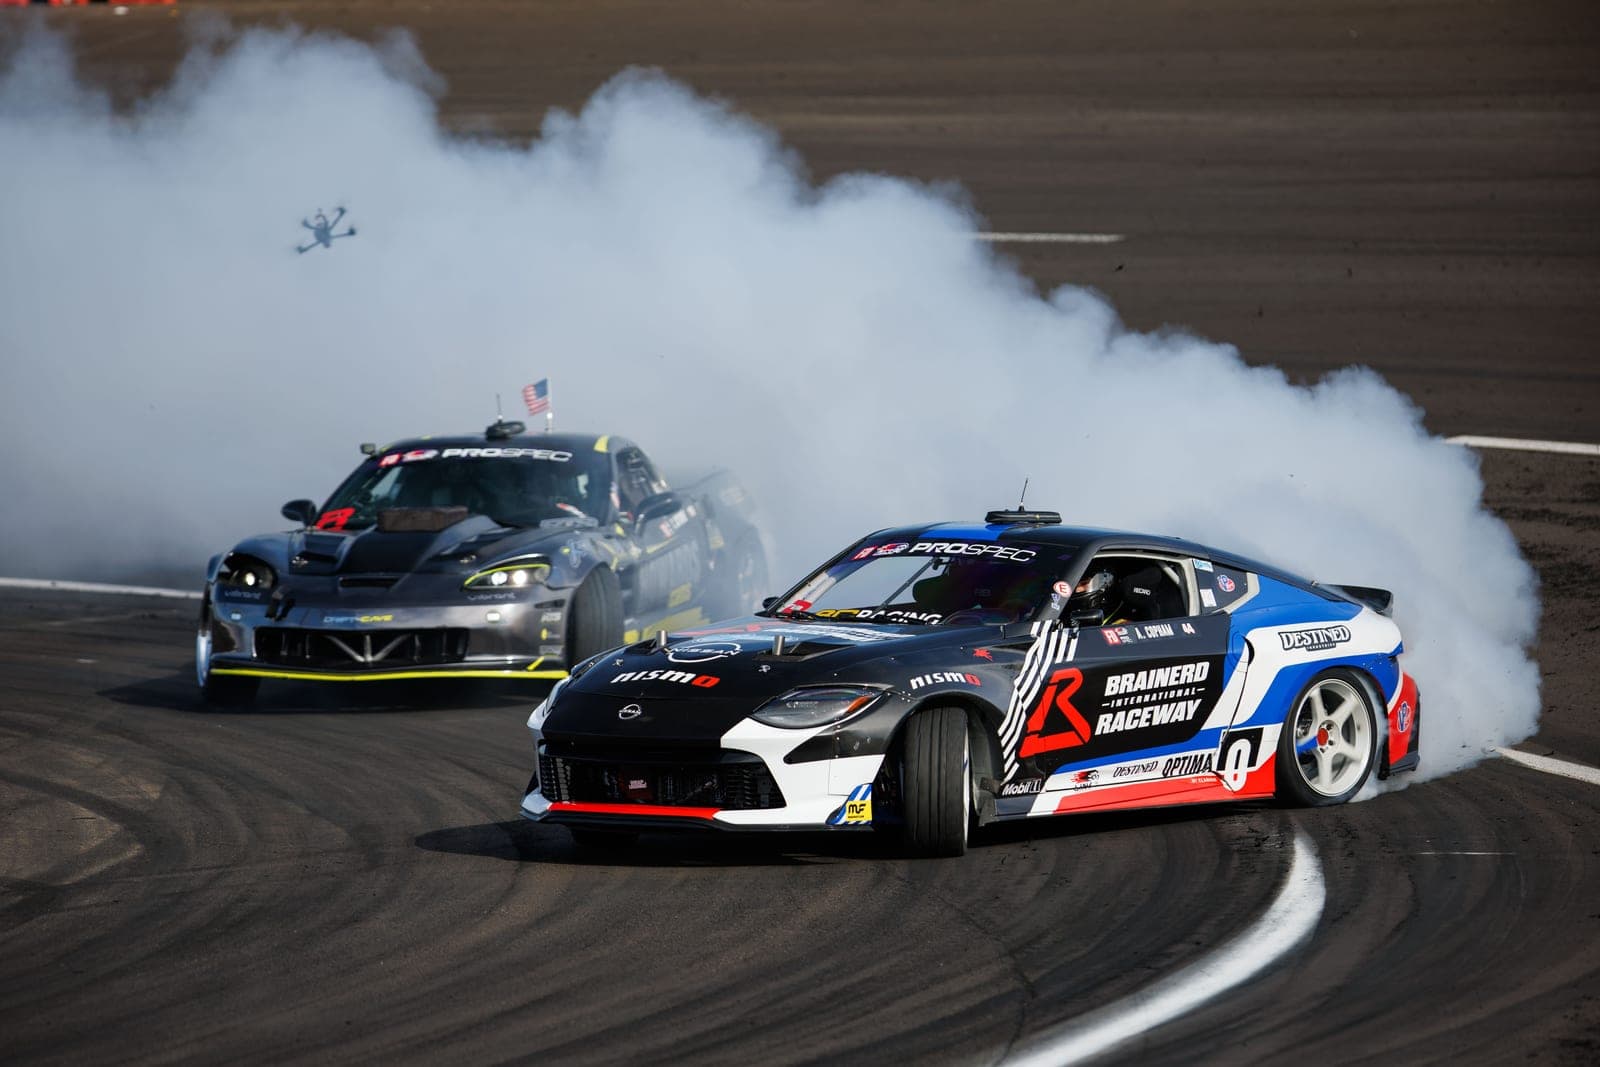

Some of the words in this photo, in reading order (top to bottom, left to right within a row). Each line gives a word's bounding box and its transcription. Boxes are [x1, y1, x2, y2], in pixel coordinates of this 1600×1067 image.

[442, 448, 573, 462] PROSPEC
[909, 542, 1036, 562] PROSPEC
[1279, 625, 1351, 650] DESTINED
[1104, 661, 1210, 697] BRAINERD
[1110, 688, 1197, 707] INTERNATIONAL
[1095, 699, 1202, 736] RACEWAY
[1112, 760, 1159, 778] DESTINED
[1162, 753, 1213, 779] OPTIMA
[1002, 782, 1030, 796] Mobil
